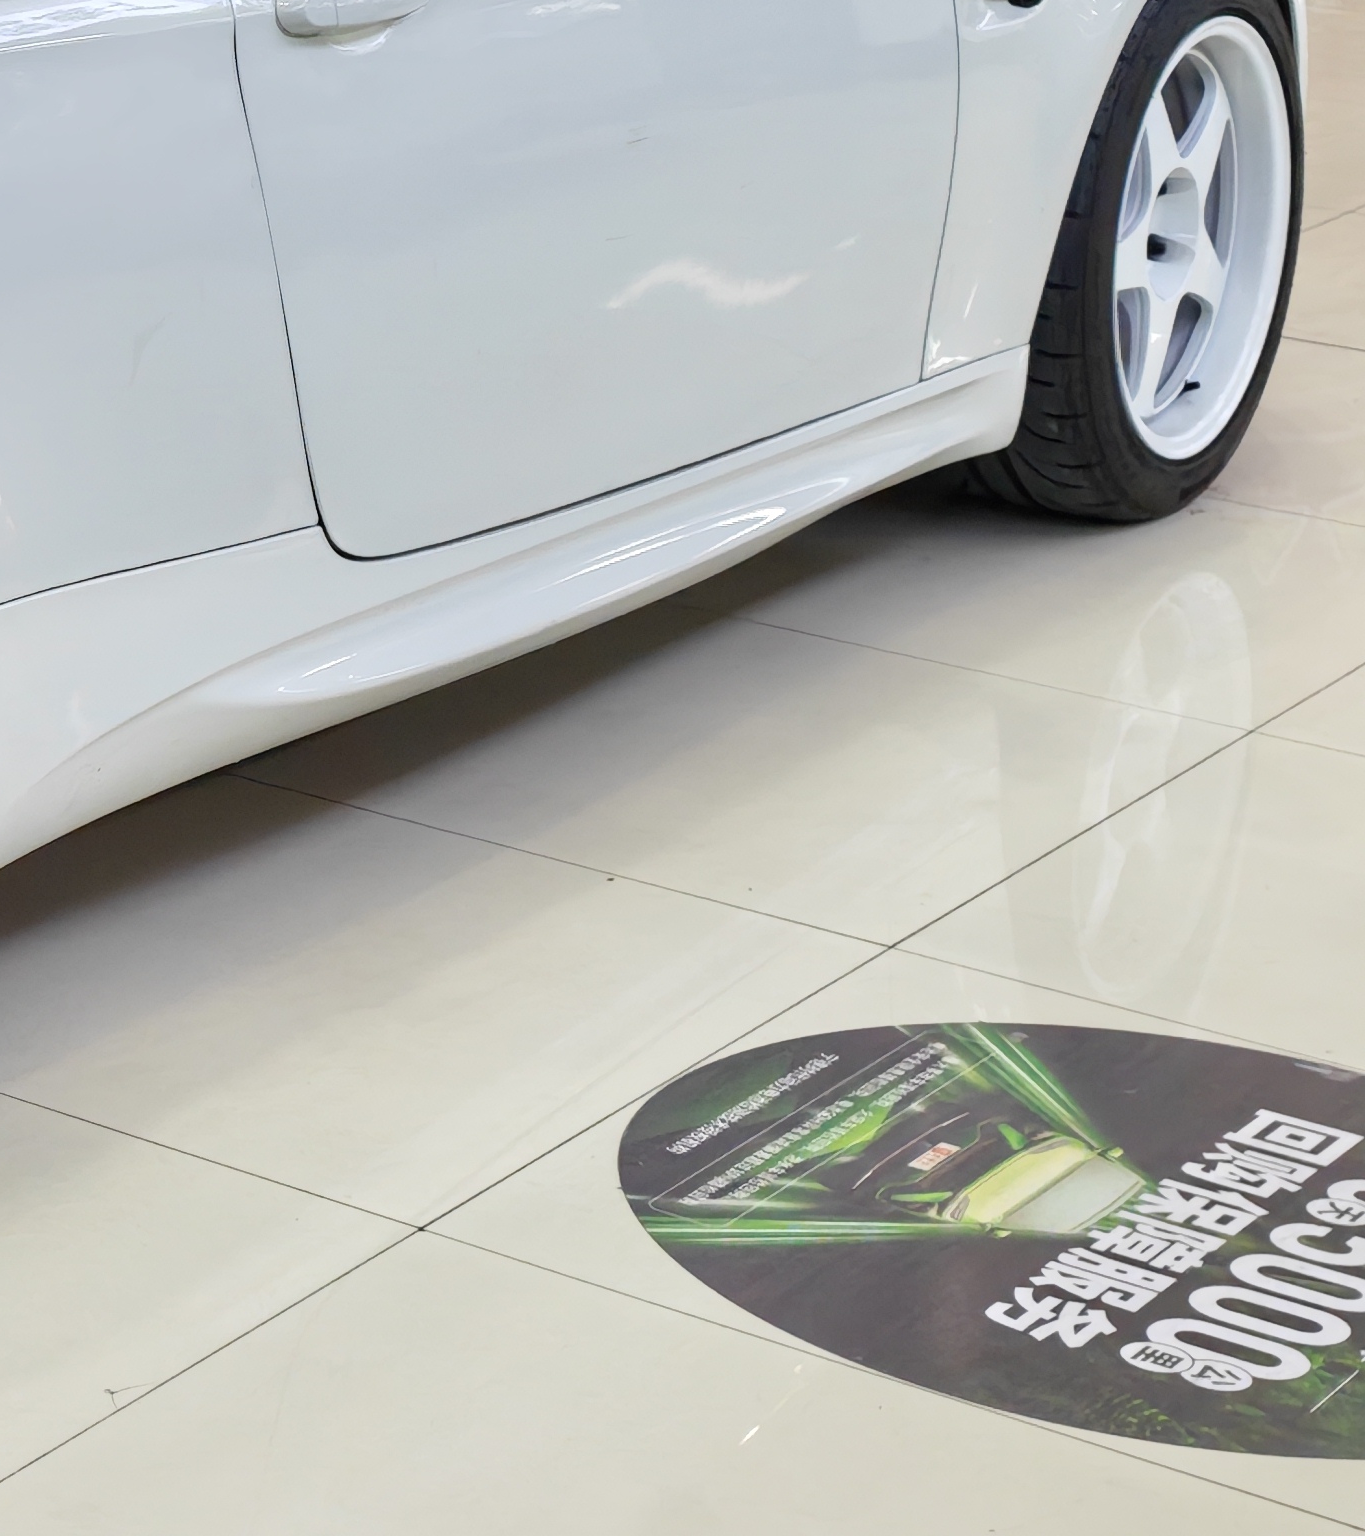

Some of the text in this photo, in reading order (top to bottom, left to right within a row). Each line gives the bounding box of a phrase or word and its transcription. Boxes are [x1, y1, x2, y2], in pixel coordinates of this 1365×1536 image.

[984, 1109, 1364, 1350] 回购保障服务
